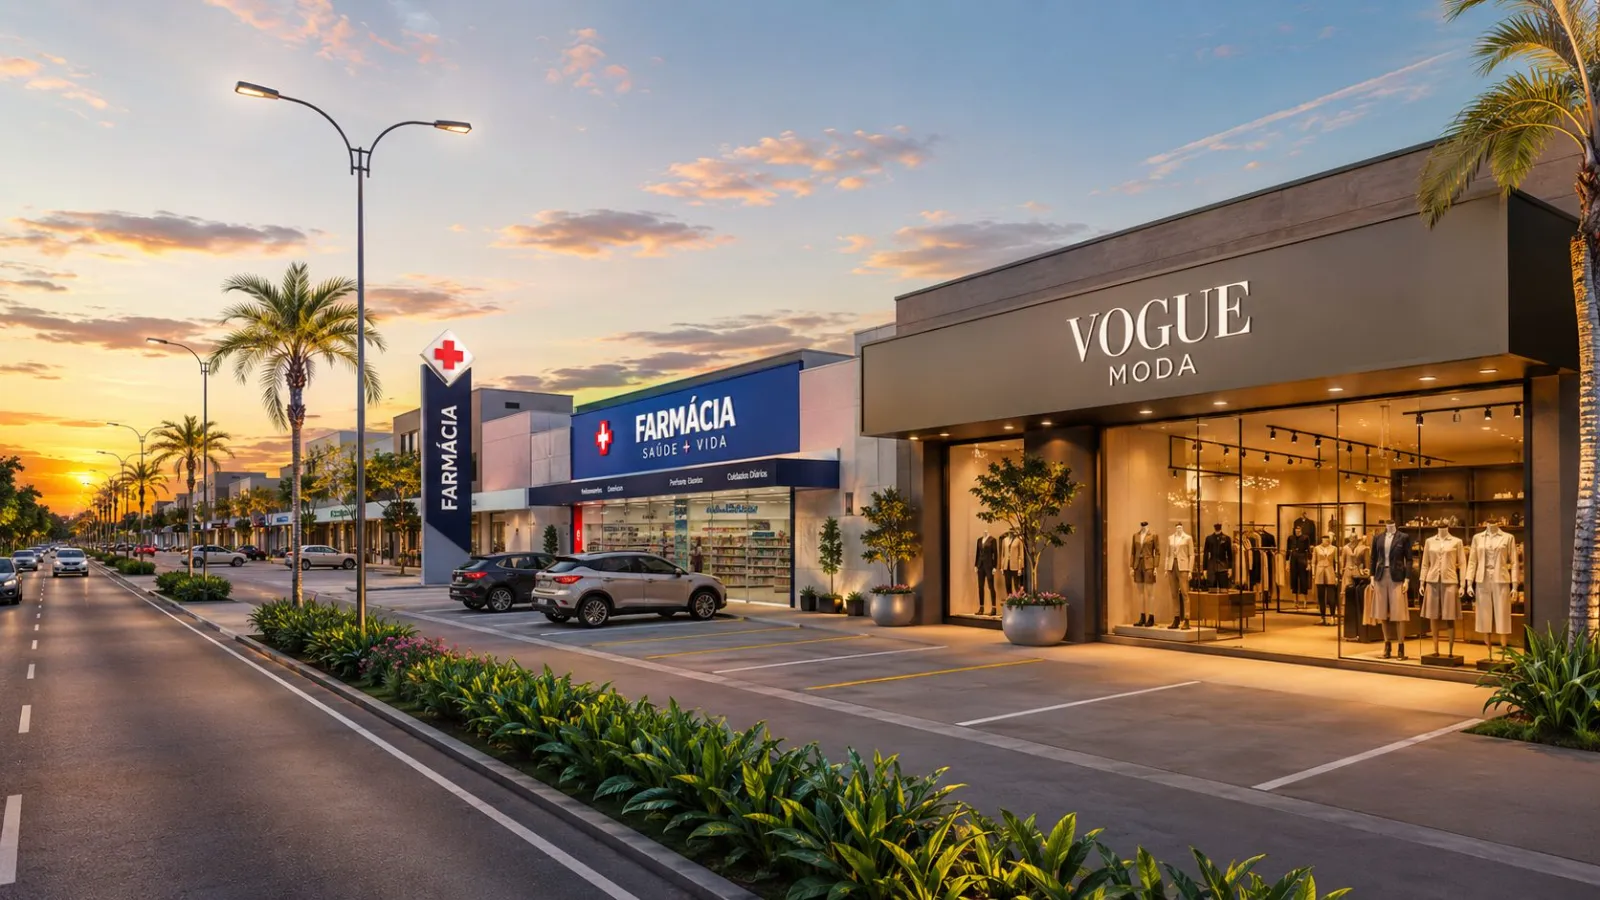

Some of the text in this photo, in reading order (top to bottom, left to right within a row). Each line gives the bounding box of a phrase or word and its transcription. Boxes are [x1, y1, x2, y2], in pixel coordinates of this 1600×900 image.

[1066, 280, 1251, 363] VOGUE
[1109, 353, 1197, 387] MODA
[635, 395, 736, 443] FARMÁCIA
[435, 405, 458, 511] FARMÁCIA
[642, 441, 678, 459] SAÚDE
[697, 434, 727, 451] VIDA
